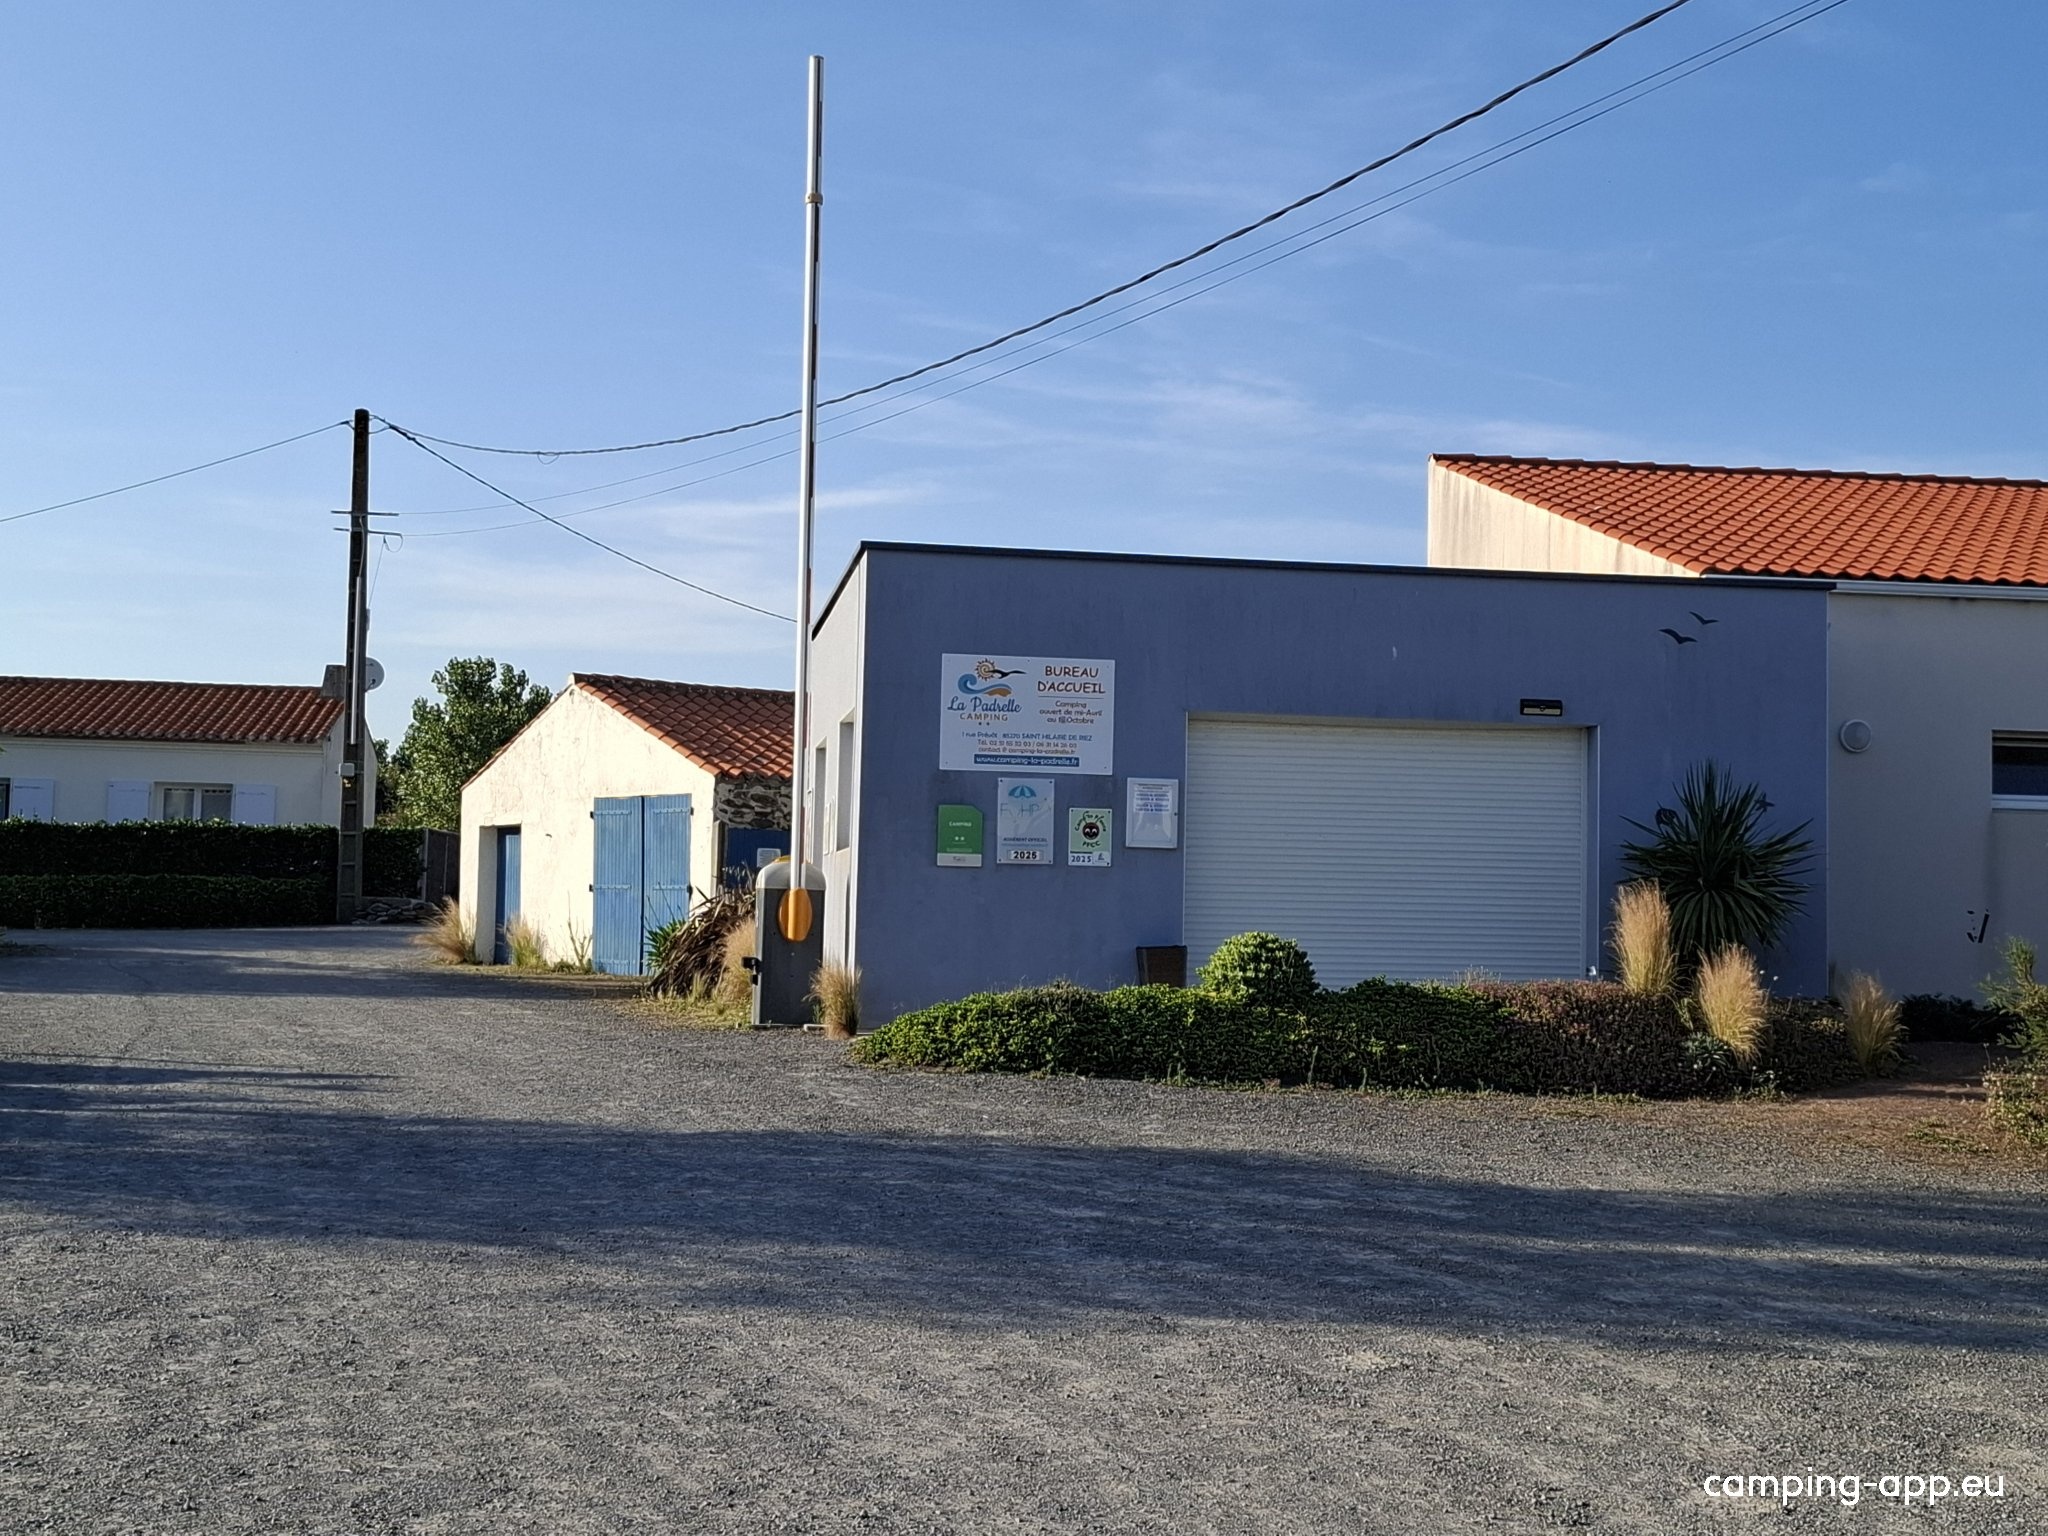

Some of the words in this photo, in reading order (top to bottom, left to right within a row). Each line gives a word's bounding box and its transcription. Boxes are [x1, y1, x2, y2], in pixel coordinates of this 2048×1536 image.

[1045, 665, 1099, 678] BUREAU
[1037, 680, 1106, 694] D'ACCUEIL
[947, 696, 967, 711] La
[970, 696, 1022, 713] Padrelle
[1055, 700, 1087, 709] Camping
[959, 713, 1008, 721] CAMPING
[1066, 716, 1094, 724] Octobre
[1041, 733, 1066, 741] HILAIRE
[1079, 734, 1093, 742] RIEZ
[1071, 855, 1092, 863] 2025
